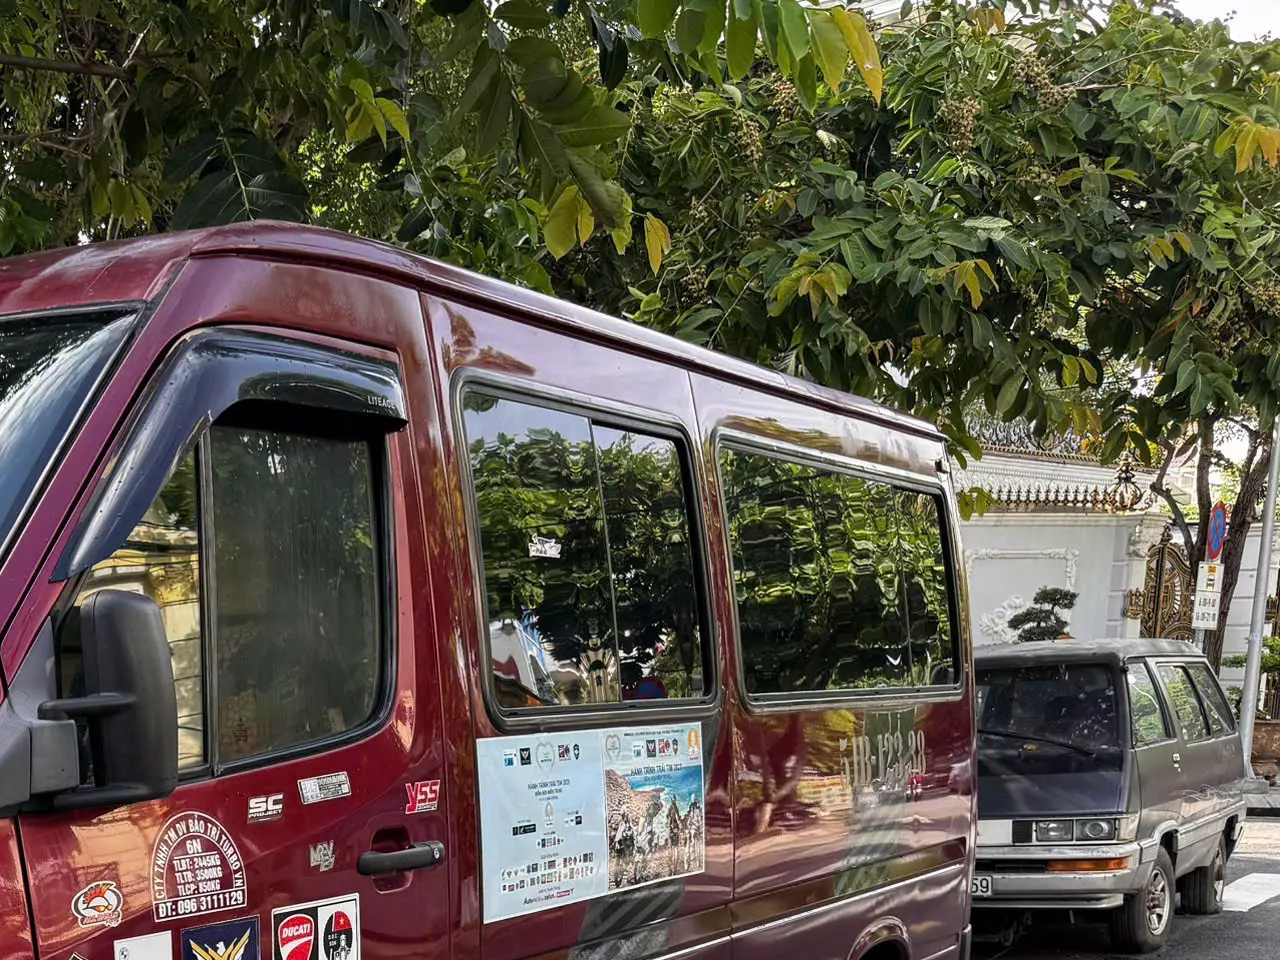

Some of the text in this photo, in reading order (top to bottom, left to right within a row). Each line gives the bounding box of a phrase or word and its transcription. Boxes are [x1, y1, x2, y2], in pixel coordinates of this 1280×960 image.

[249, 794, 283, 813] SC
[154, 845, 170, 873] TNHH
[164, 828, 178, 845] TM
[176, 821, 187, 835] DV
[188, 815, 205, 833] BẢO
[219, 834, 241, 870] TURBO
[234, 871, 243, 887] VN
[185, 839, 202, 854] 6N
[158, 891, 244, 918] ĐT: 096 3111129
[282, 923, 311, 938] DUCATI
